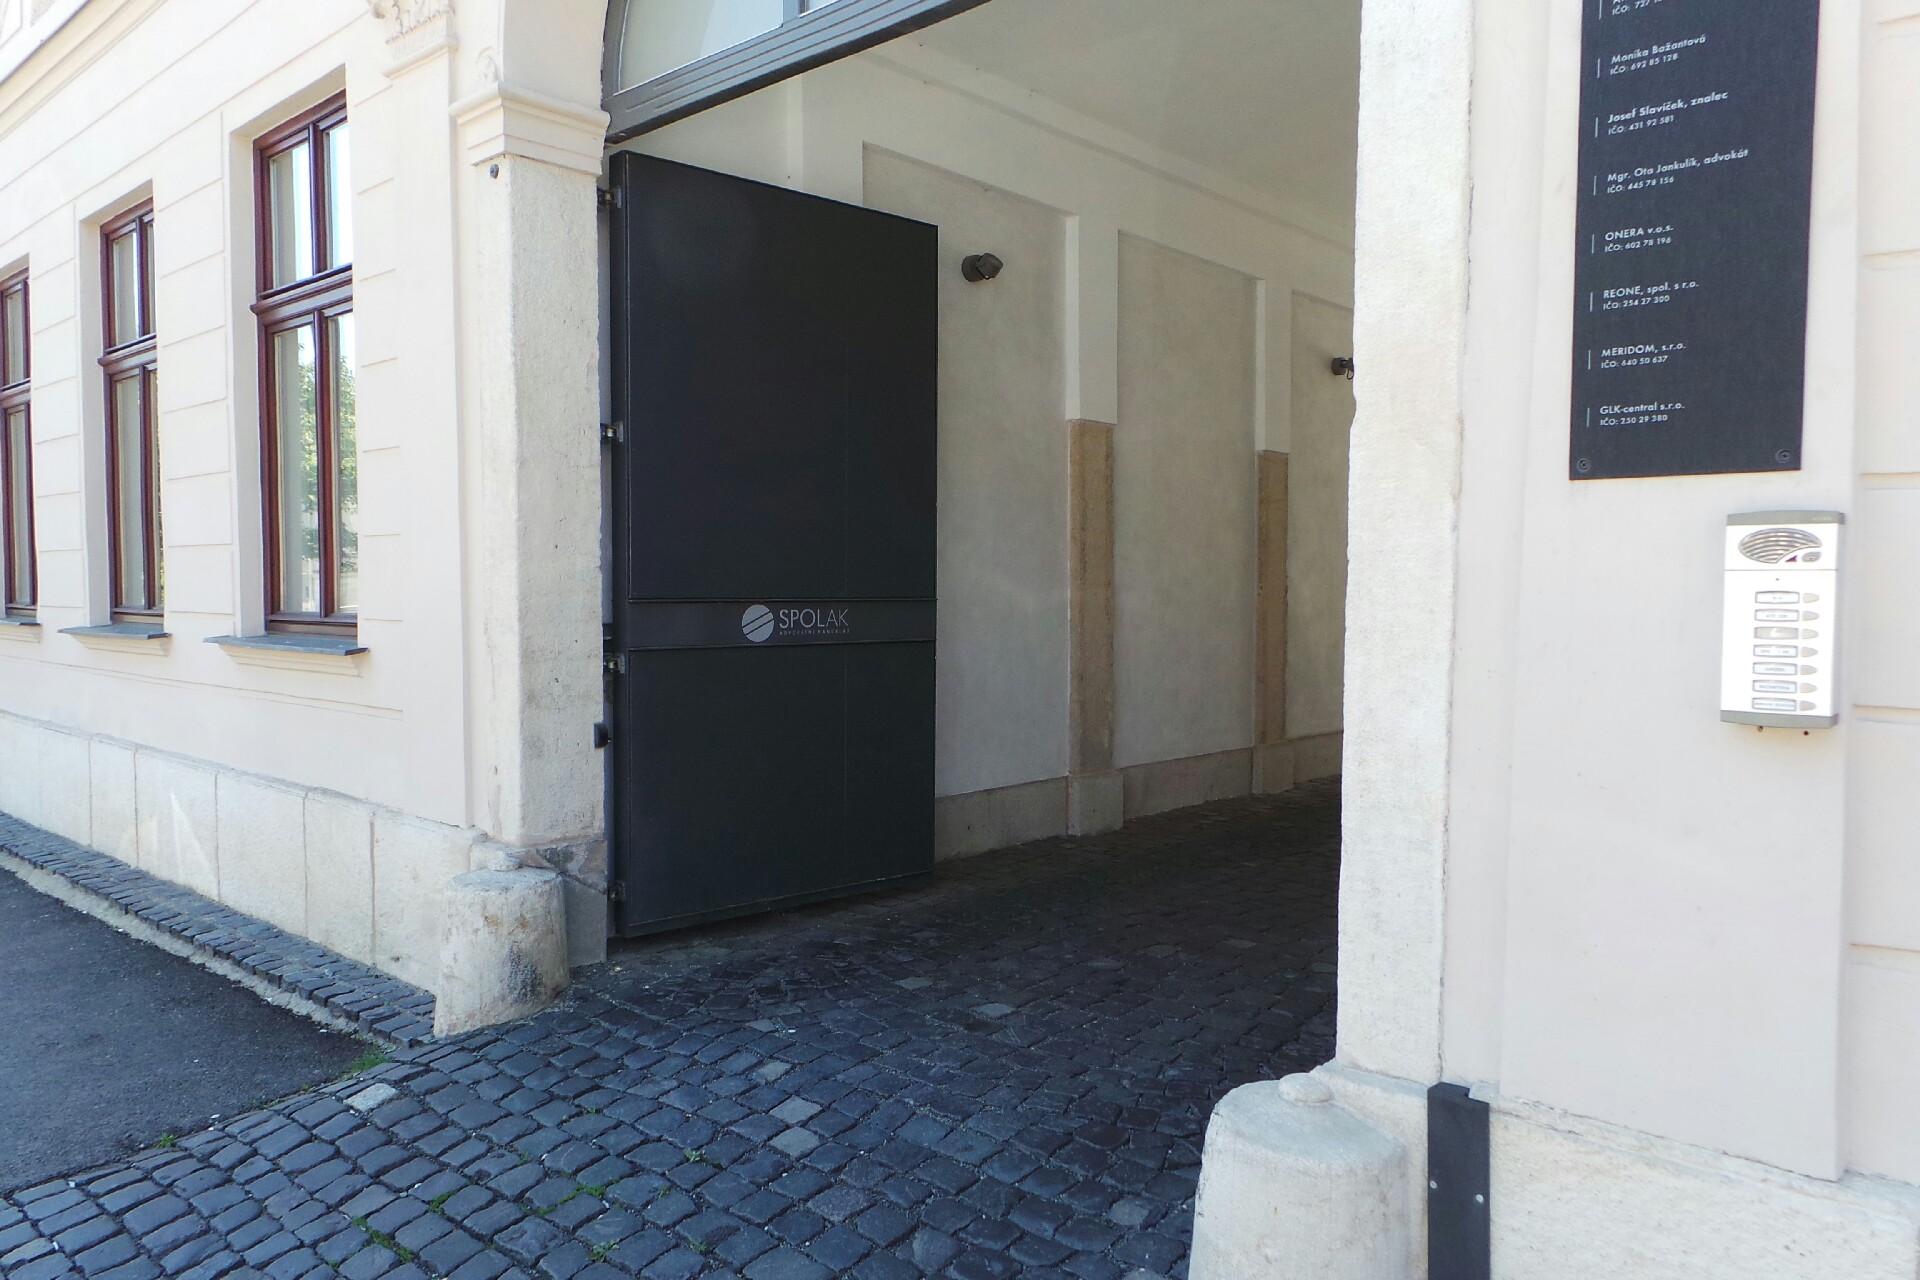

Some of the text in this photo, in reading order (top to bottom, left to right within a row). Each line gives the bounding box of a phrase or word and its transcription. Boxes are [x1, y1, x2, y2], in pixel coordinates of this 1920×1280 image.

[1612, 5, 1630, 15] IČO:
[1611, 34, 1706, 64] Monika Bažantová
[1610, 53, 1678, 76] IČO: 692 85 128
[1608, 90, 1728, 123] Josef Slavíček, znalec
[1608, 114, 1674, 136] IČO: 431 92 581
[1607, 148, 1749, 182] Mgr. Ota Jankulík, advokát
[1607, 174, 1674, 194] IČO: 445 78 156
[1604, 224, 1674, 242] ONERA v.o.s.
[1604, 236, 1672, 252] IČO: 602 78 196
[1603, 280, 1699, 300] REONE, spol. s r.o.
[1603, 294, 1670, 310] IČO: 254 27 300
[1601, 341, 1687, 358] MERIDOM, s.r.o.
[1601, 355, 1669, 369] IČO: 640 50 637
[1600, 401, 1686, 415] GLK-central s.r.o.
[1600, 414, 1668, 426] IČO: 250 29 380
[779, 608, 849, 628] SPOLAK
